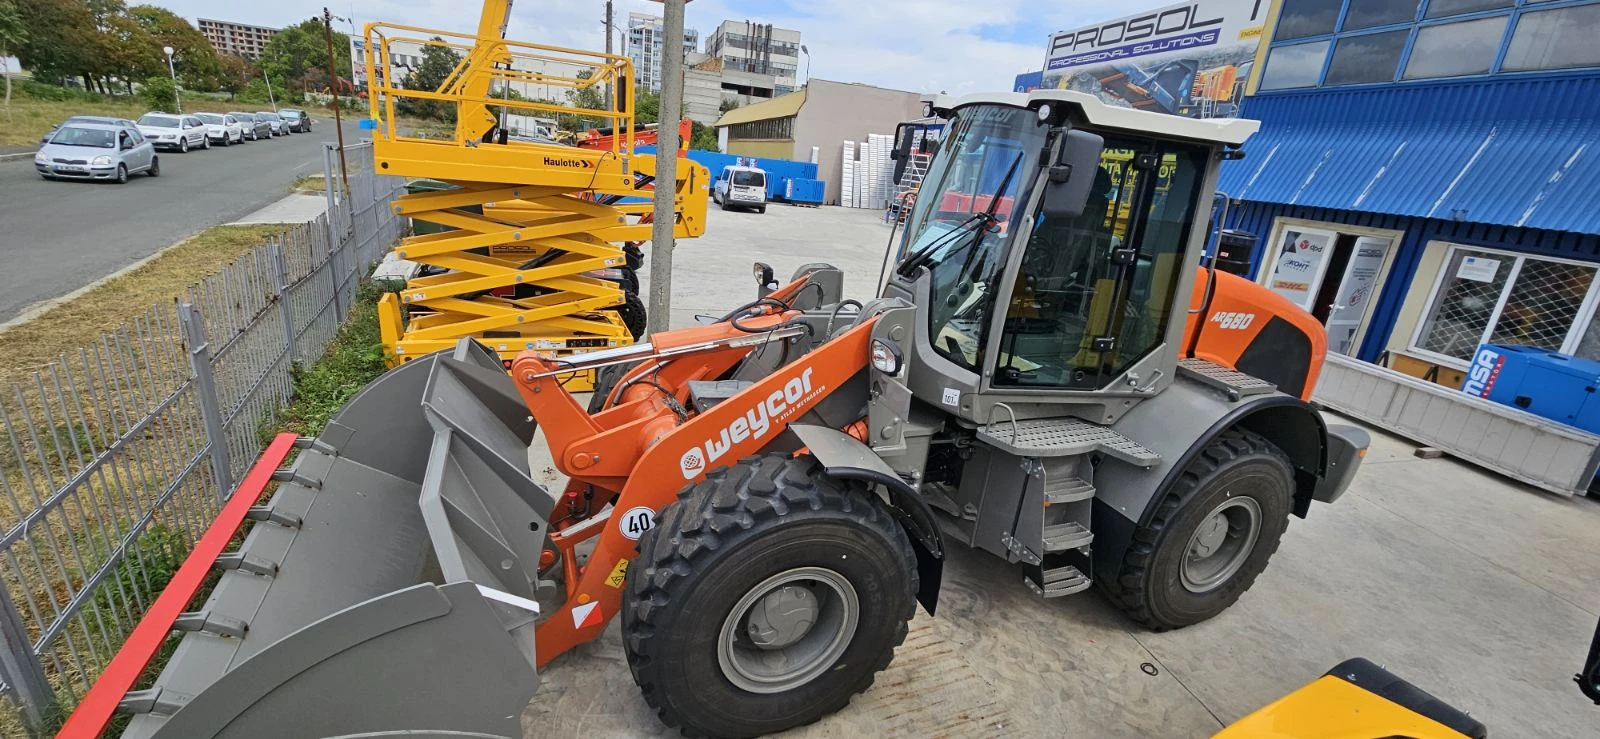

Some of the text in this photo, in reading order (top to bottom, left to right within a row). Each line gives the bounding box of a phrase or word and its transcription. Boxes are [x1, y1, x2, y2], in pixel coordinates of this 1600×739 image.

[1050, 4, 1224, 55] PROSOL
[1050, 33, 1215, 67] PROFESSIONAL SOLUTIONS
[543, 157, 580, 168] Haulotte
[1310, 245, 1323, 253] dpd
[1462, 350, 1499, 396] MSA
[1483, 363, 1503, 396] ERATOR
[705, 366, 813, 462] weycor
[628, 512, 650, 534] 40
